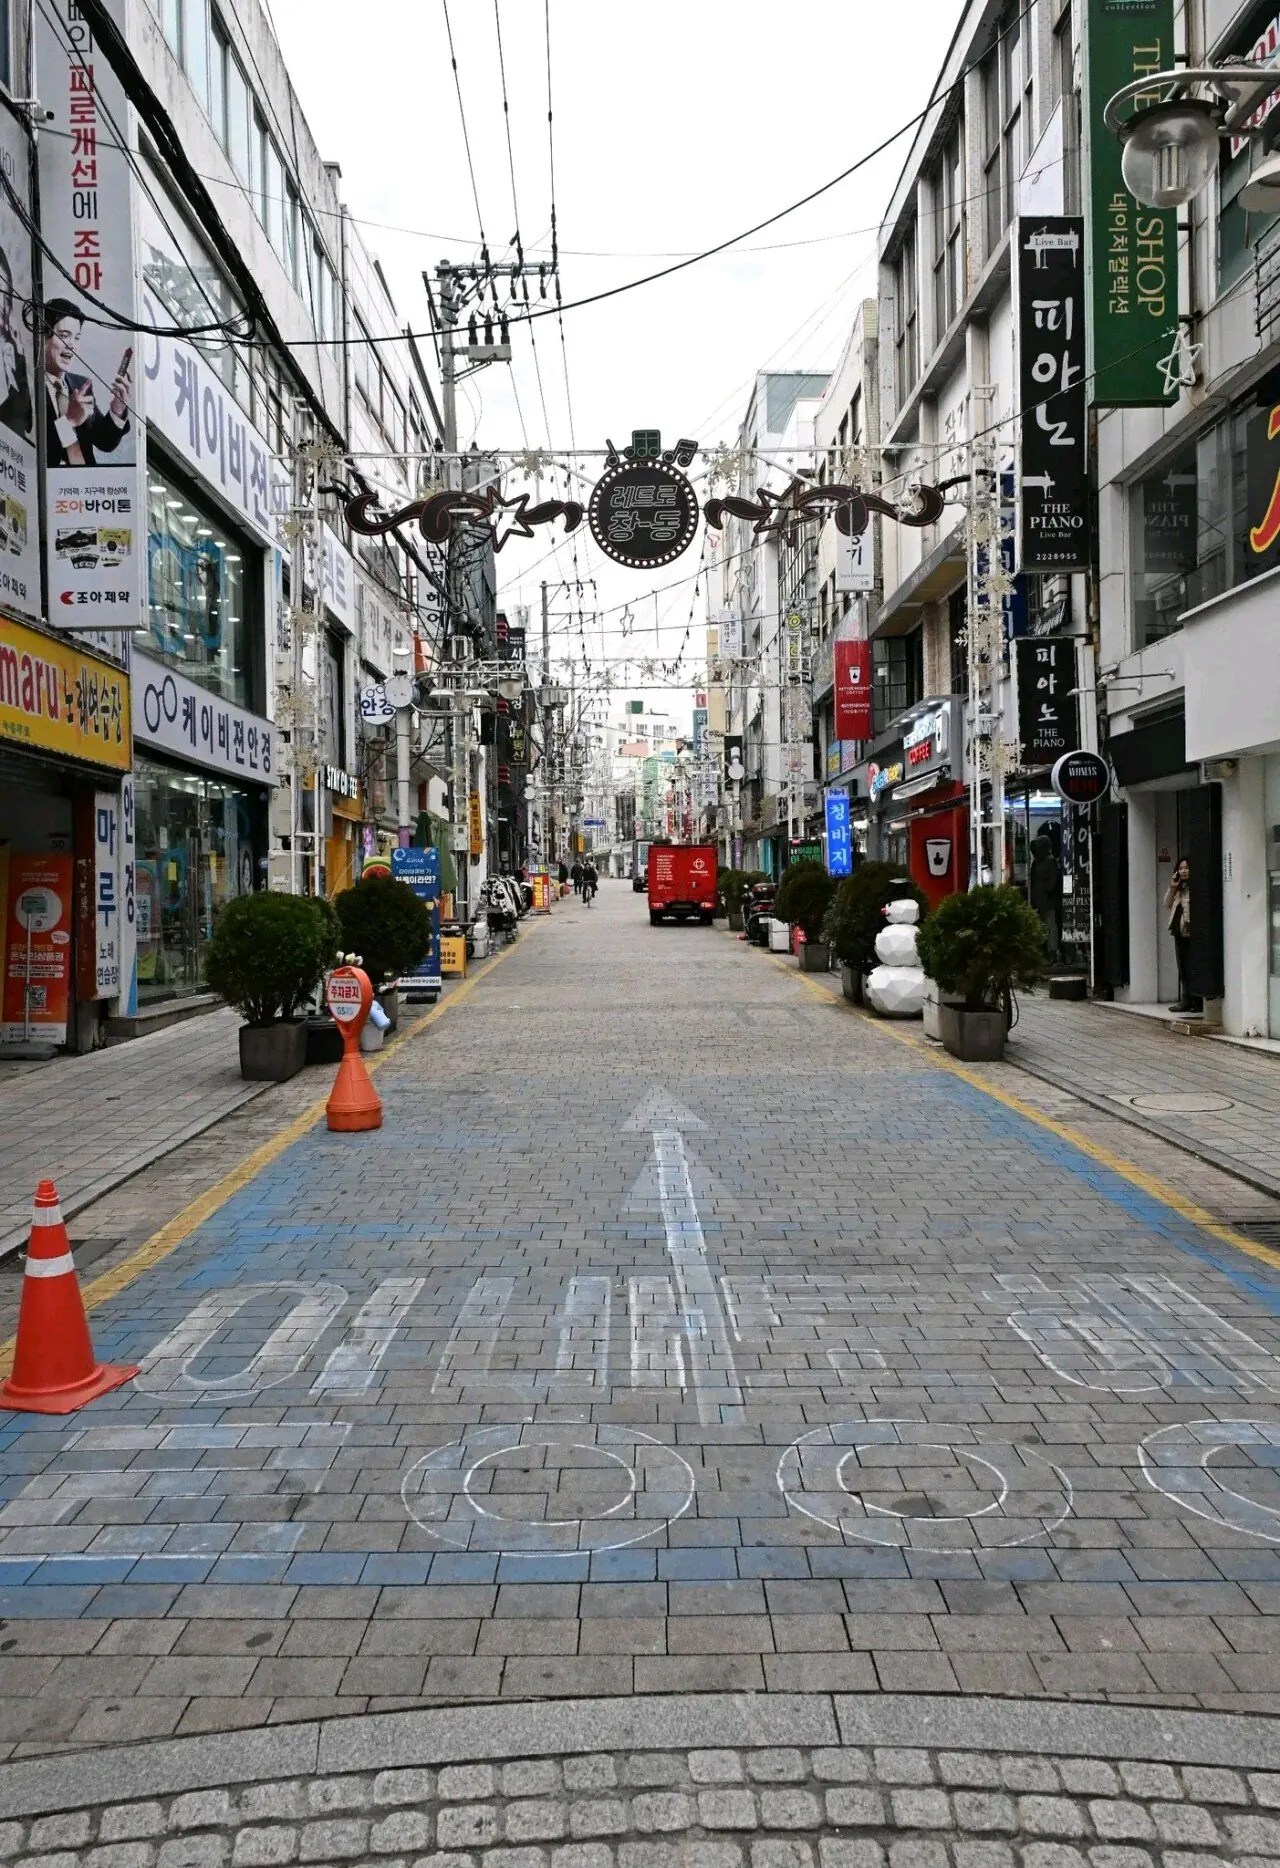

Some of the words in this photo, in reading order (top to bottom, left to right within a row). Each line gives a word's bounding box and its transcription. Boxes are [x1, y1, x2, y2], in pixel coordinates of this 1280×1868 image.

[69, 64, 98, 220] 피로개선에
[73, 230, 103, 291] 조아
[1035, 238, 1054, 246] Live
[1057, 238, 1073, 246] Bar
[1108, 193, 1130, 315] 네이처컬렉션
[1136, 217, 1166, 317] SHOP
[1031, 296, 1081, 446] 피아노
[55, 499, 131, 513] 조아바이톤
[610, 485, 678, 508] 레트로
[1041, 504, 1070, 513] THE
[1030, 516, 1083, 529] PIANO
[1036, 645, 1059, 722] 피아노
[63, 666, 122, 744] 노래연습장
[1033, 738, 1065, 748] PIANO
[1038, 729, 1058, 737] THE
[123, 782, 136, 923] 안경
[829, 803, 849, 866] 청바지
[97, 809, 116, 928] 마루
[100, 942, 114, 959] 노래
[97, 966, 117, 985] 연습장
[331, 986, 359, 999] 주차금지
